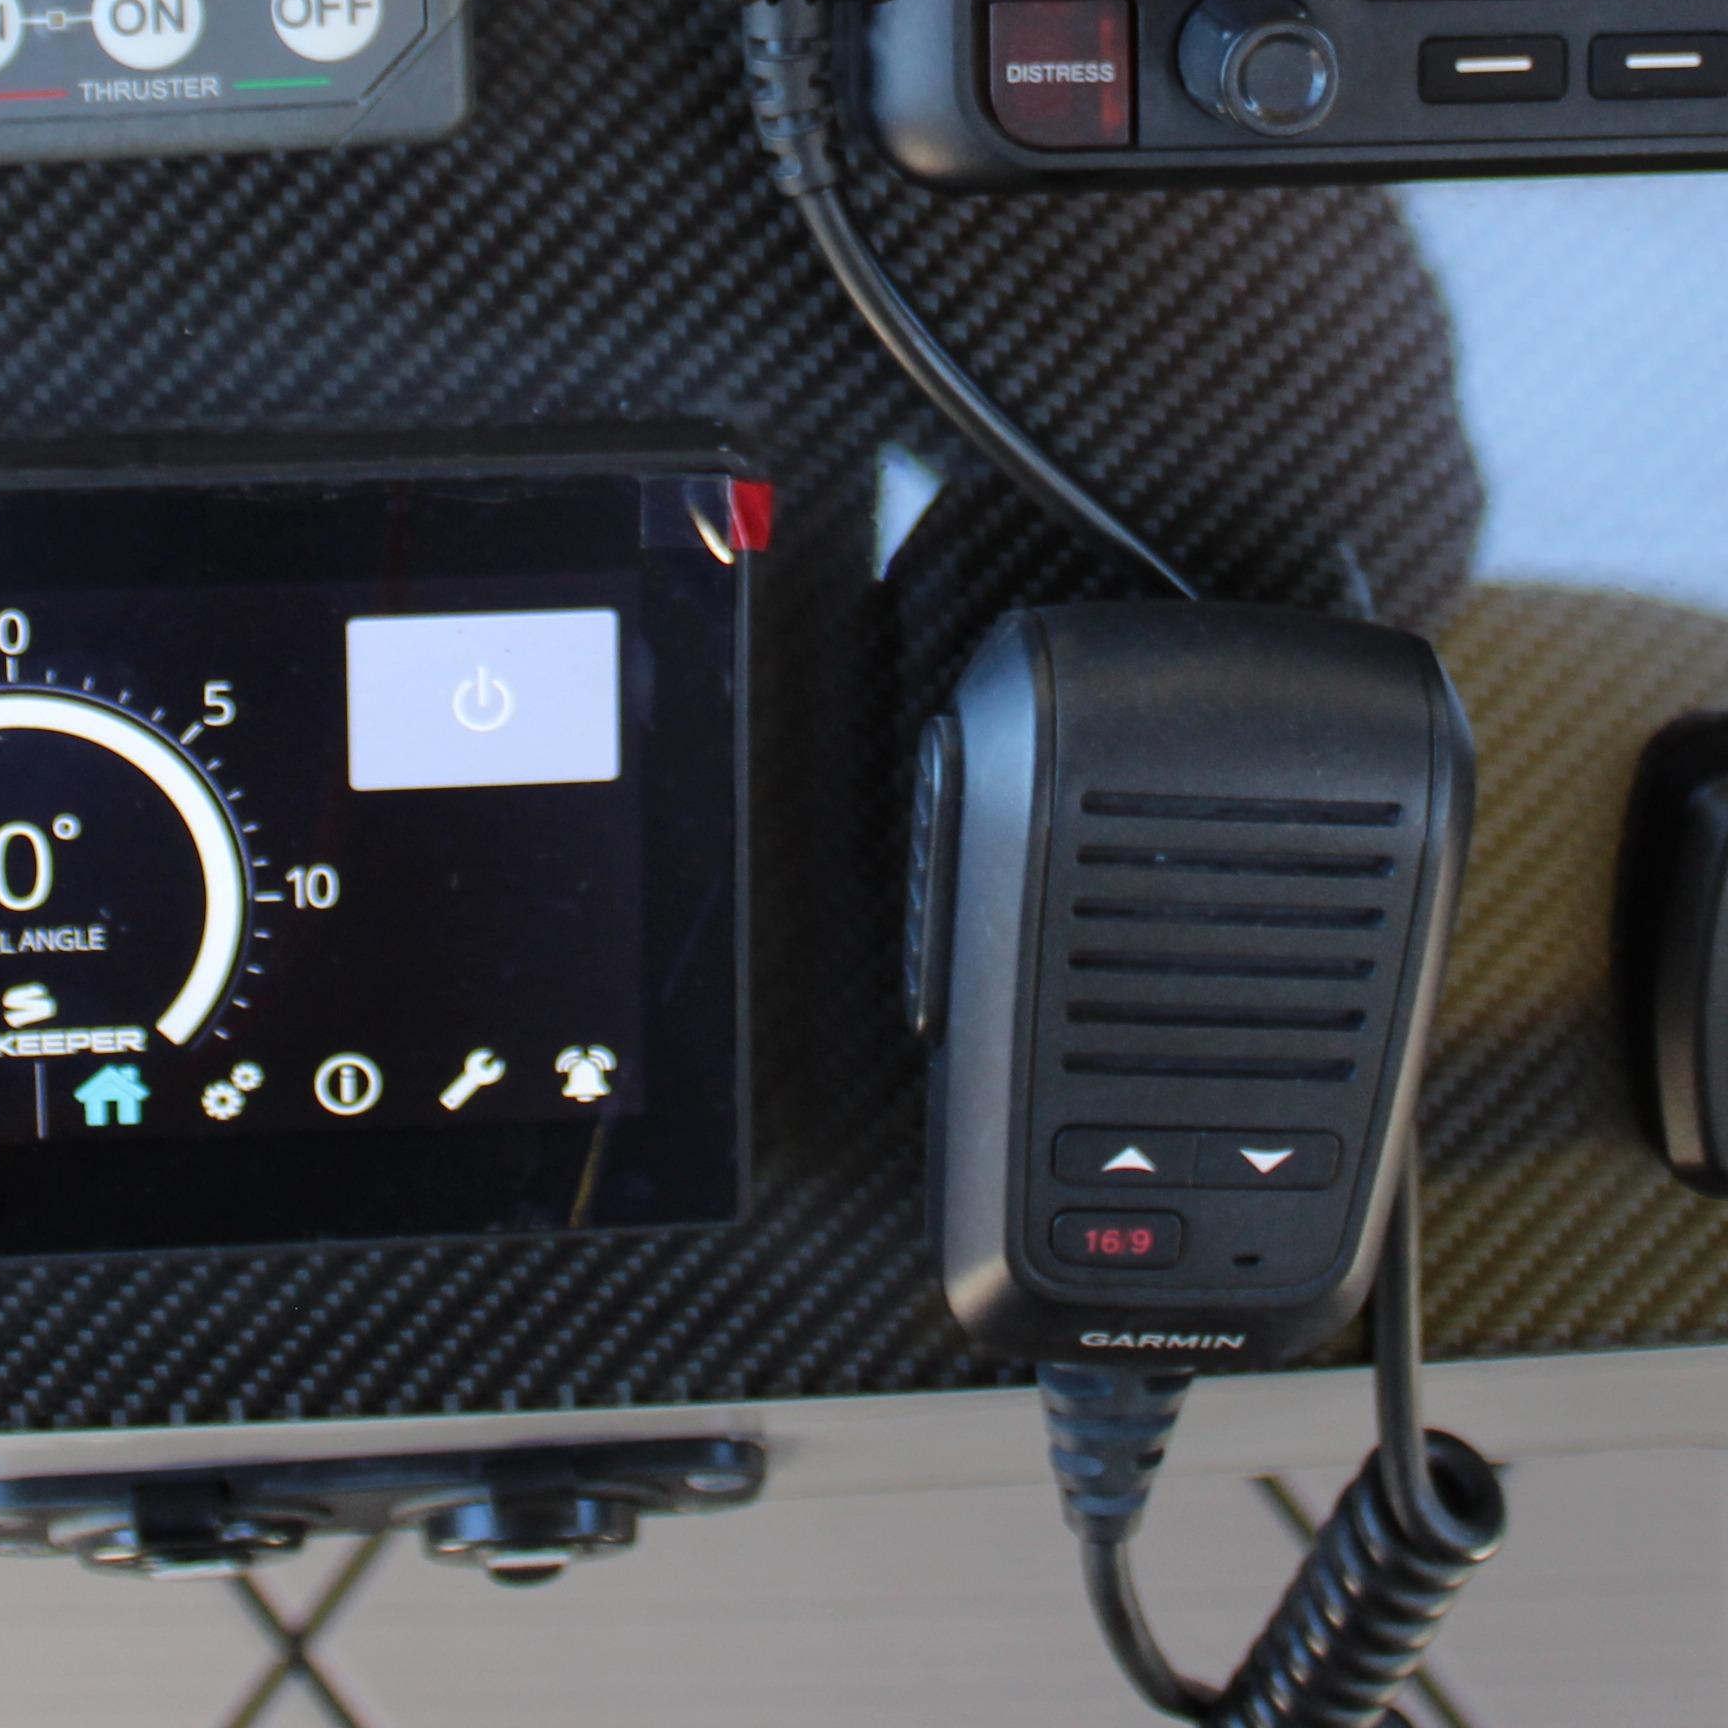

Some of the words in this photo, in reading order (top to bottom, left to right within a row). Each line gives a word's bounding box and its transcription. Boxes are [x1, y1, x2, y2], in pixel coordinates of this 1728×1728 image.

[1005, 62, 1115, 85] DISTRESS
[78, 75, 220, 104] THRUSTER
[202, 680, 237, 727] 5
[285, 863, 341, 910] 10
[18, 924, 106, 953] ANGLE
[1079, 1331, 1247, 1350] GARMIN
